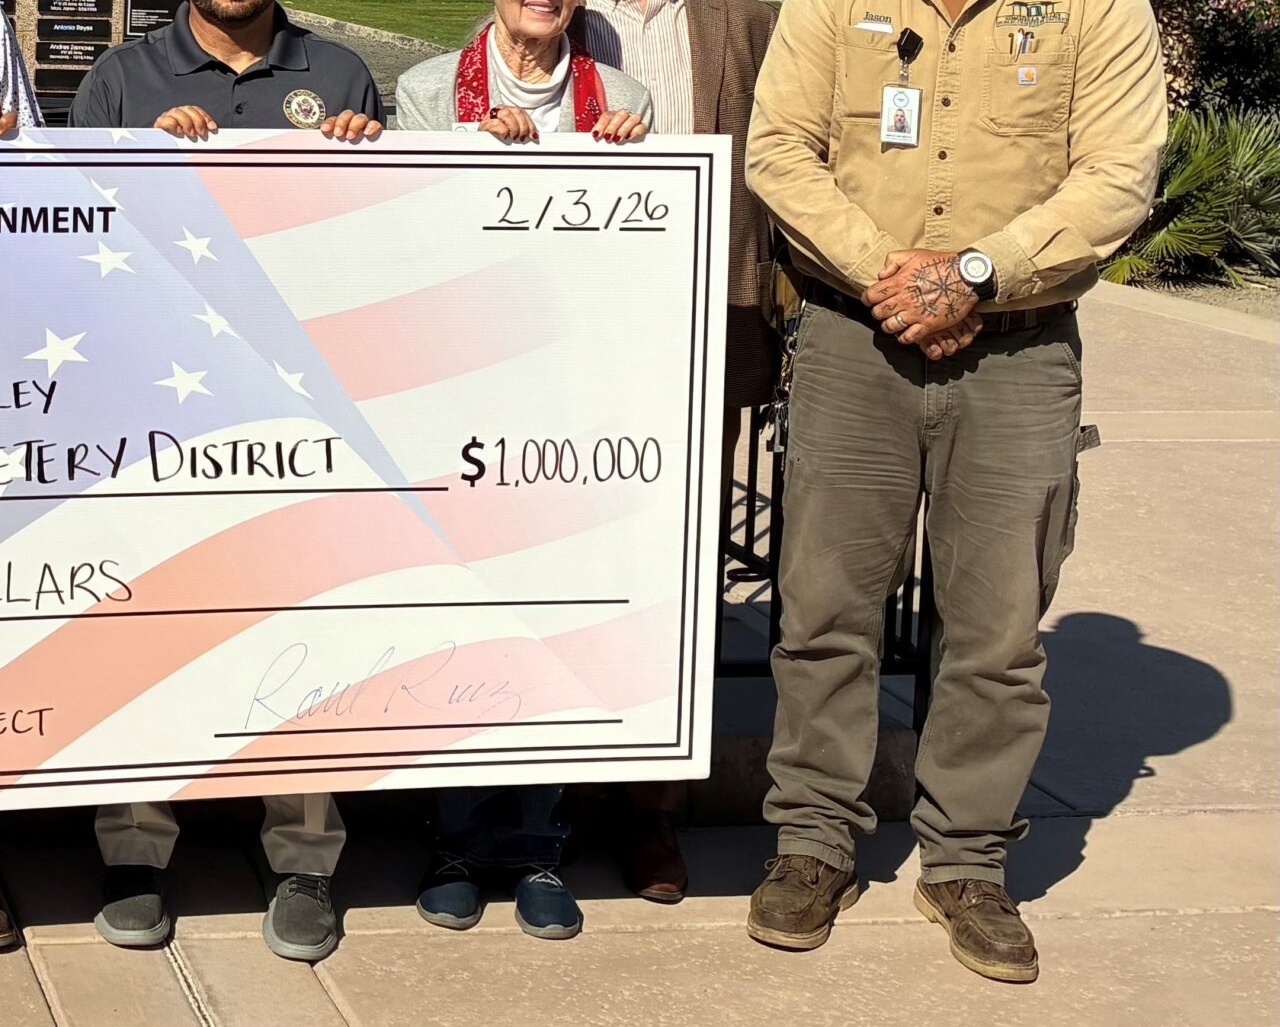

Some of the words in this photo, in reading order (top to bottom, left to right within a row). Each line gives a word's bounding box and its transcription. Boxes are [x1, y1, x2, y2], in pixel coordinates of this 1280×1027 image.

[863, 11, 892, 23] Jason
[149, 430, 342, 483] DISTRICT
[461, 434, 663, 488] $1,000,000
